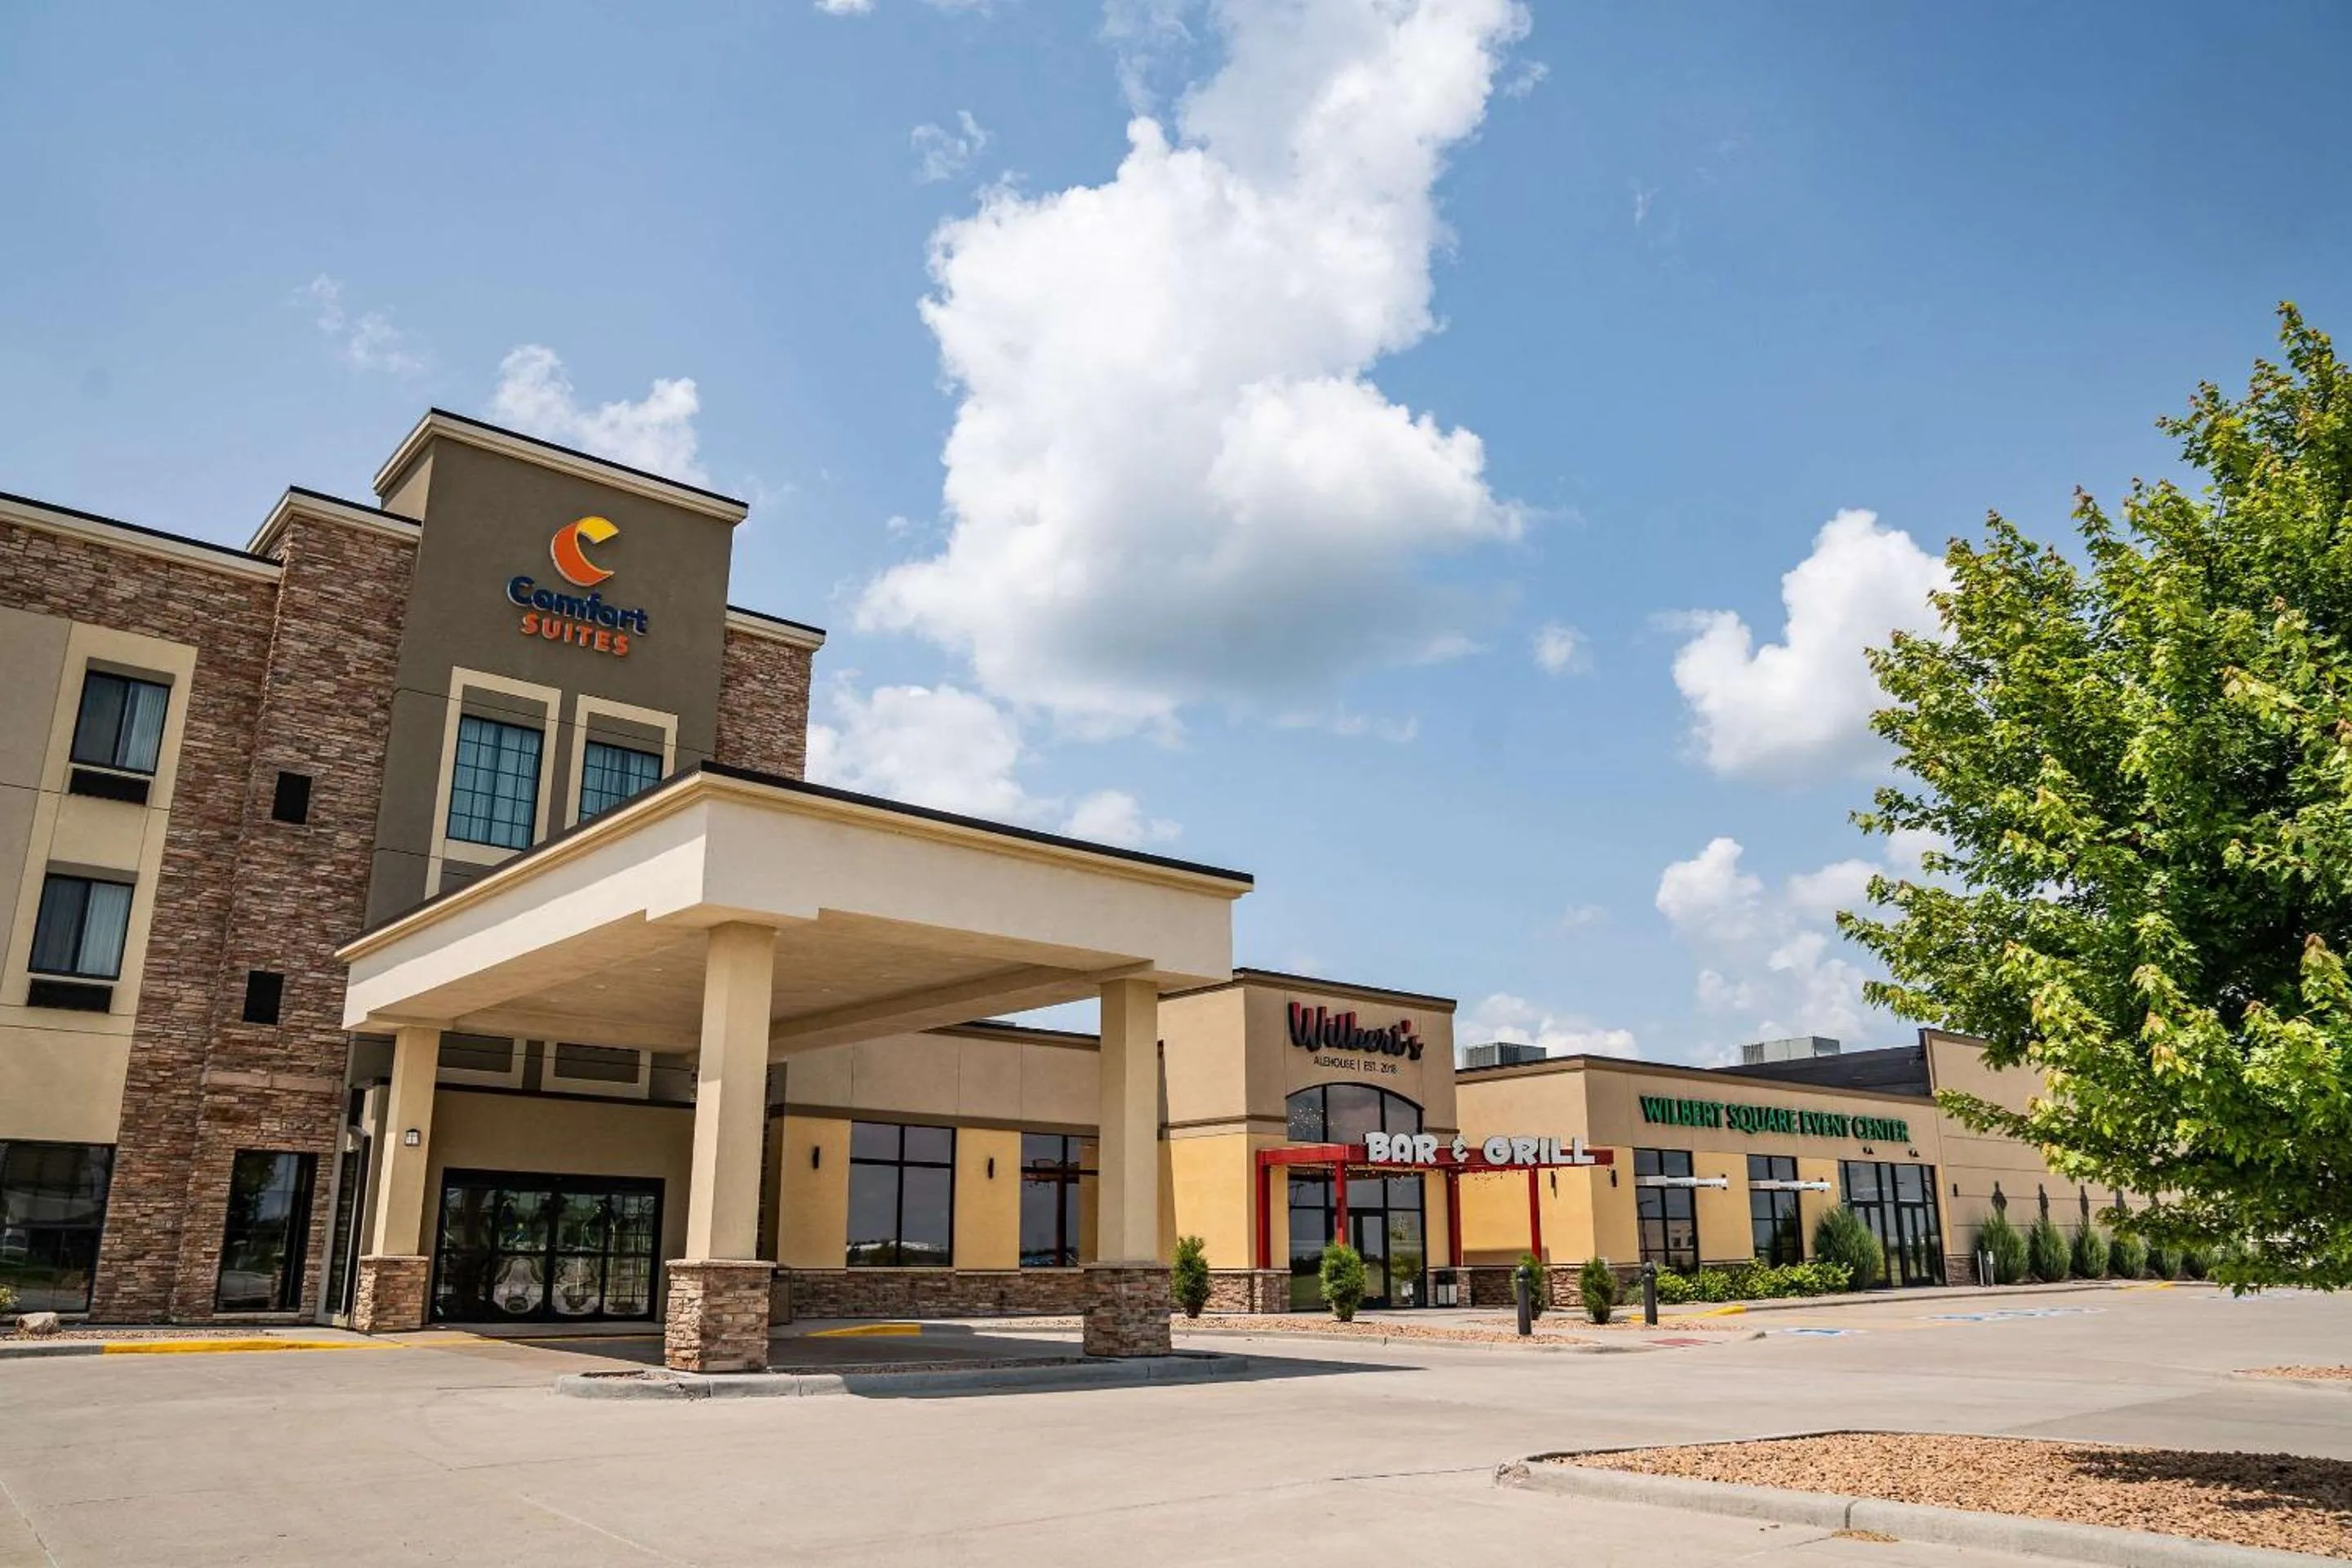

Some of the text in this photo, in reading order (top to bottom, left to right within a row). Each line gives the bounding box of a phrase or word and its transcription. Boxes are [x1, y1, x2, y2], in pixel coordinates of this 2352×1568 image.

[506, 576, 648, 635] Comfort
[520, 611, 629, 657] SUITES
[1288, 1001, 1424, 1061] Wilbert's
[1313, 1056, 1356, 1071] ALEHOUSE
[1363, 1061, 1379, 1072] EST.
[1639, 1096, 1911, 1143] WILBERT SQUARE EVENT CENTER
[1364, 1131, 1596, 1165] BAR & GRILL
